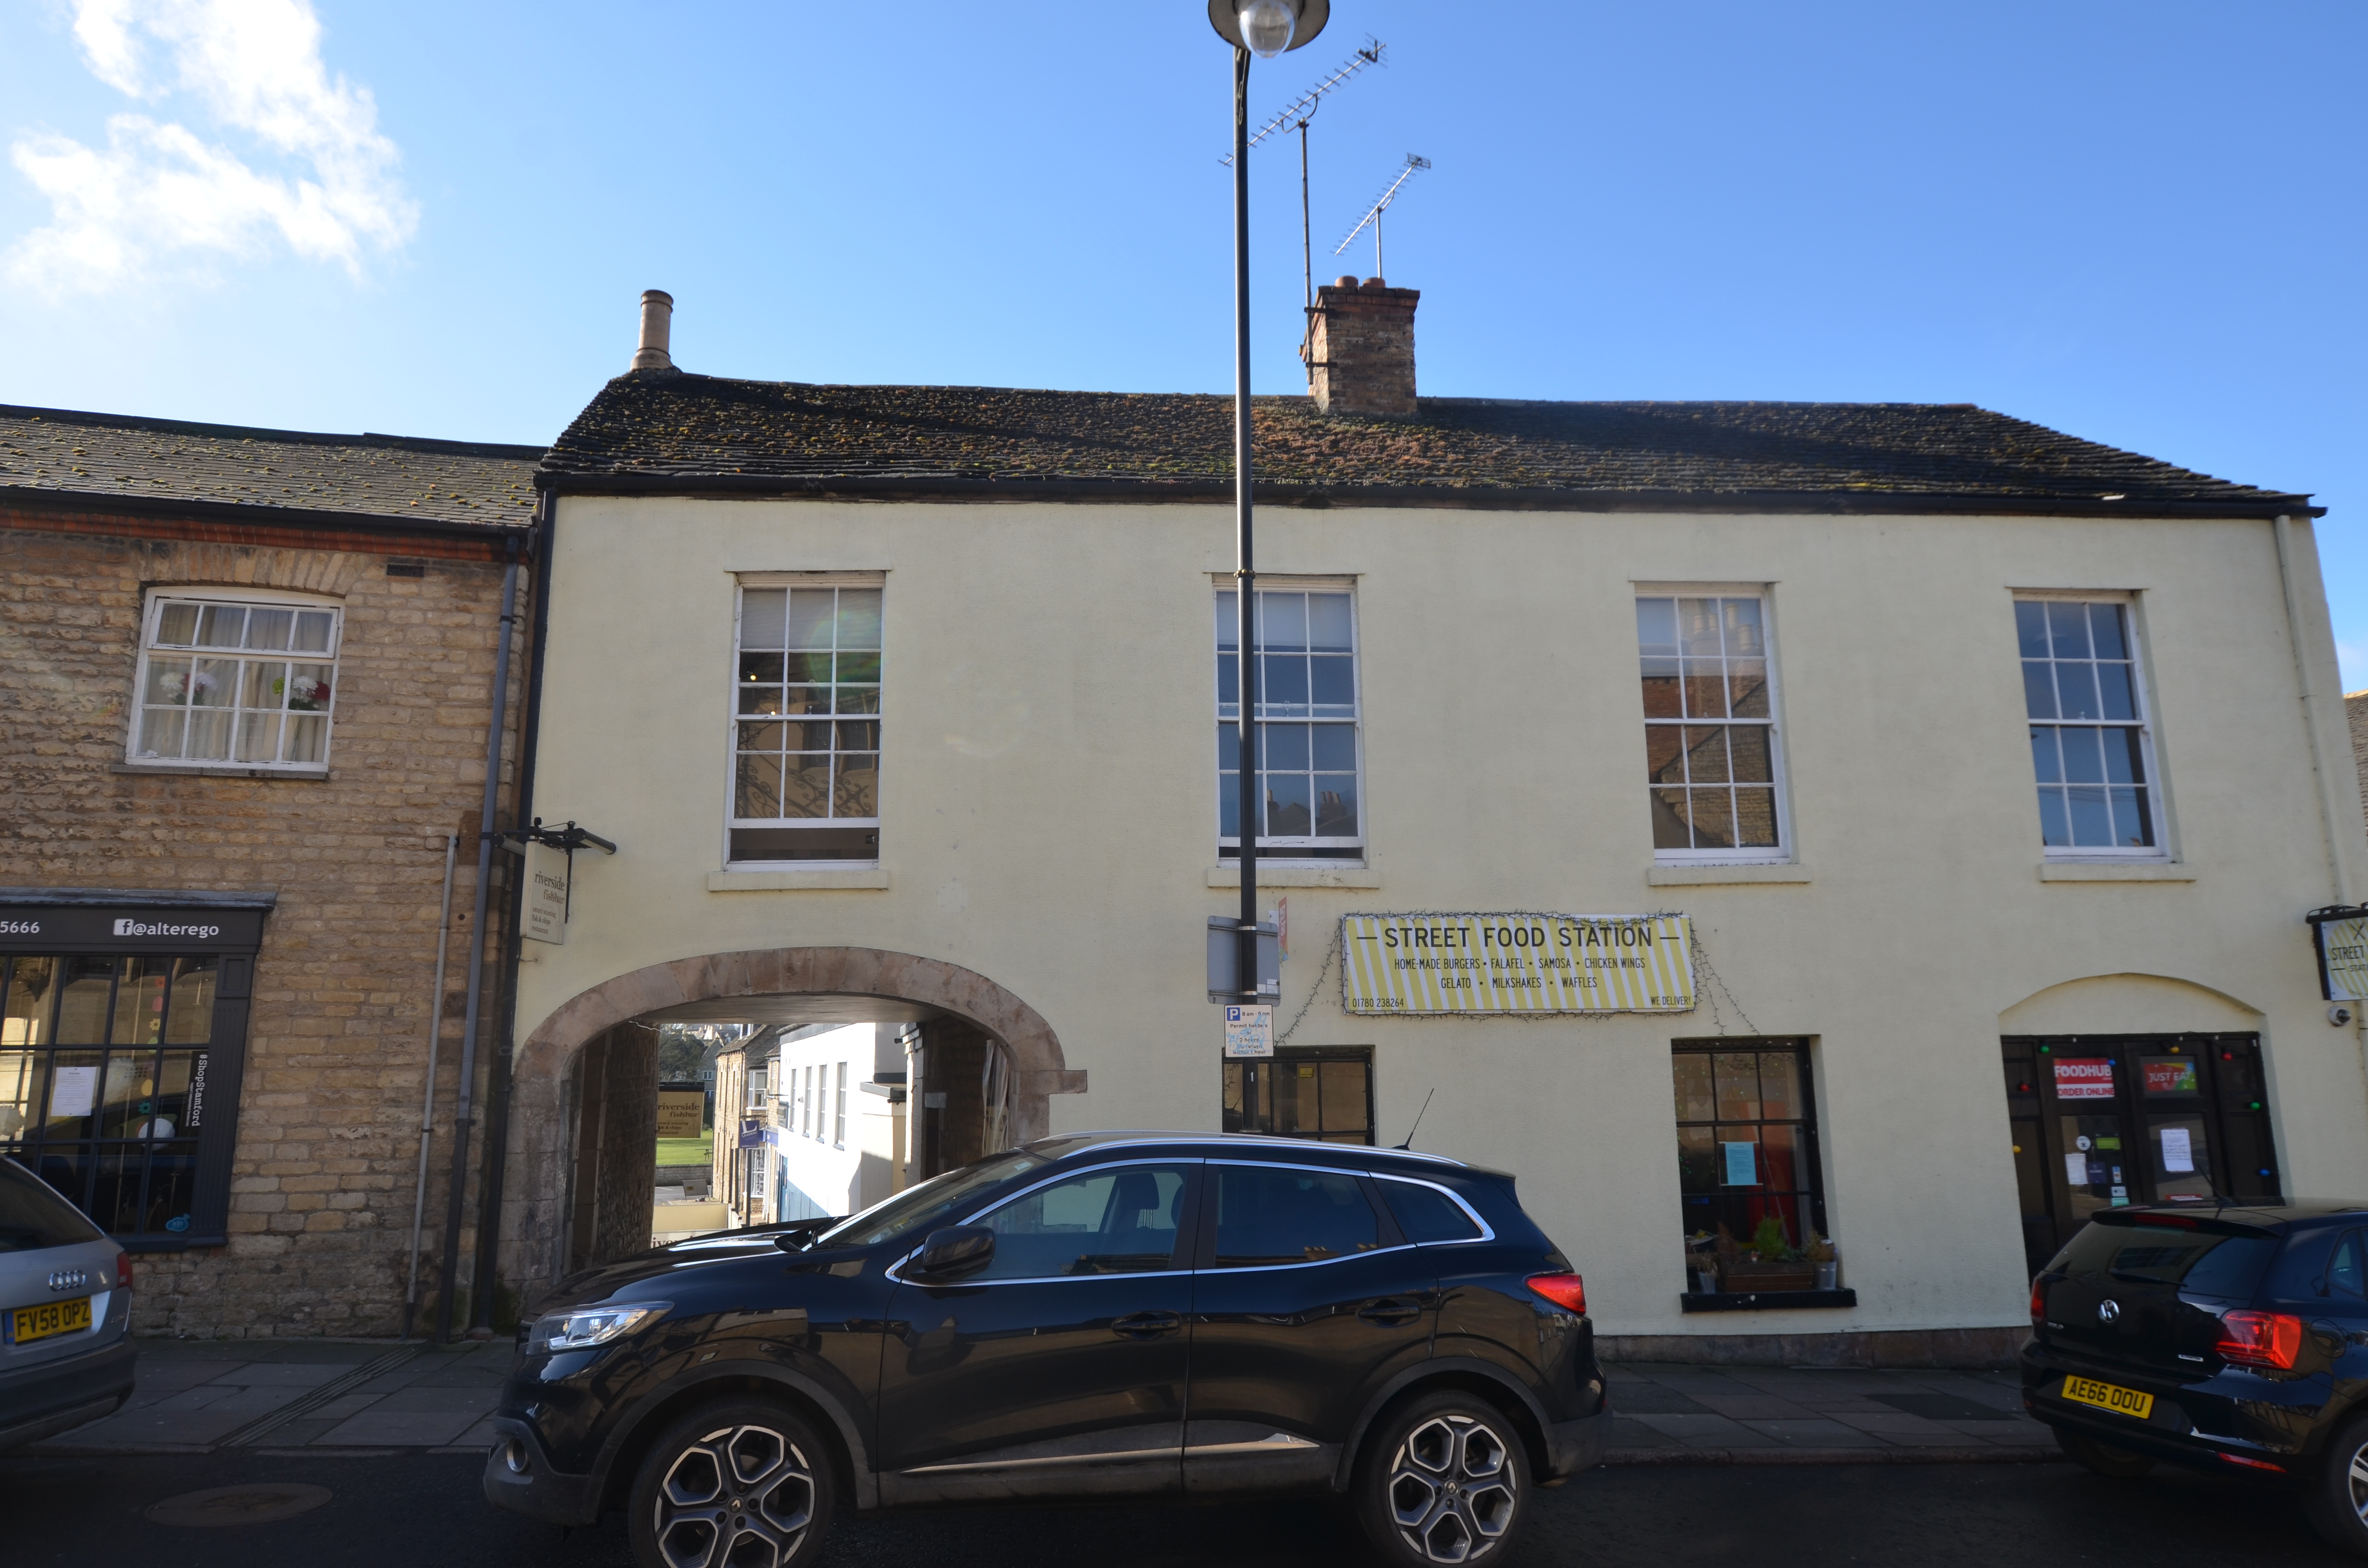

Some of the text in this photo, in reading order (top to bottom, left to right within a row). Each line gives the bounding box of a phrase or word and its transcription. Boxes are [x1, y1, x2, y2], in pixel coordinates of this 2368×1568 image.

[535, 871, 565, 891] riverside
[543, 889, 564, 904] fishbar
[0, 921, 40, 933] 5666
[133, 922, 219, 938] @alterego
[1385, 927, 1652, 948] STREET FOOD STATION
[2331, 945, 2364, 960] STREET
[1394, 957, 1645, 969] HOME-MADE BURGERS FALAFEL SAMOSA CHICKEN WINGS
[1441, 977, 1598, 989] GELATO MILKSHAKES WAFFLES
[1352, 998, 1404, 1007] 01780 238264
[1651, 996, 1691, 1005] WE DELIVER!
[2054, 1064, 2112, 1078] FOODHUB
[2148, 1072, 2190, 1083] JUST EAT
[192, 1054, 208, 1127] #ShopStamford
[2058, 1088, 2114, 1096] ORDER ONLINE
[658, 1102, 700, 1111] riverside
[17, 1301, 90, 1336] FV58 OPZ
[2069, 1379, 2108, 1403] AE66
